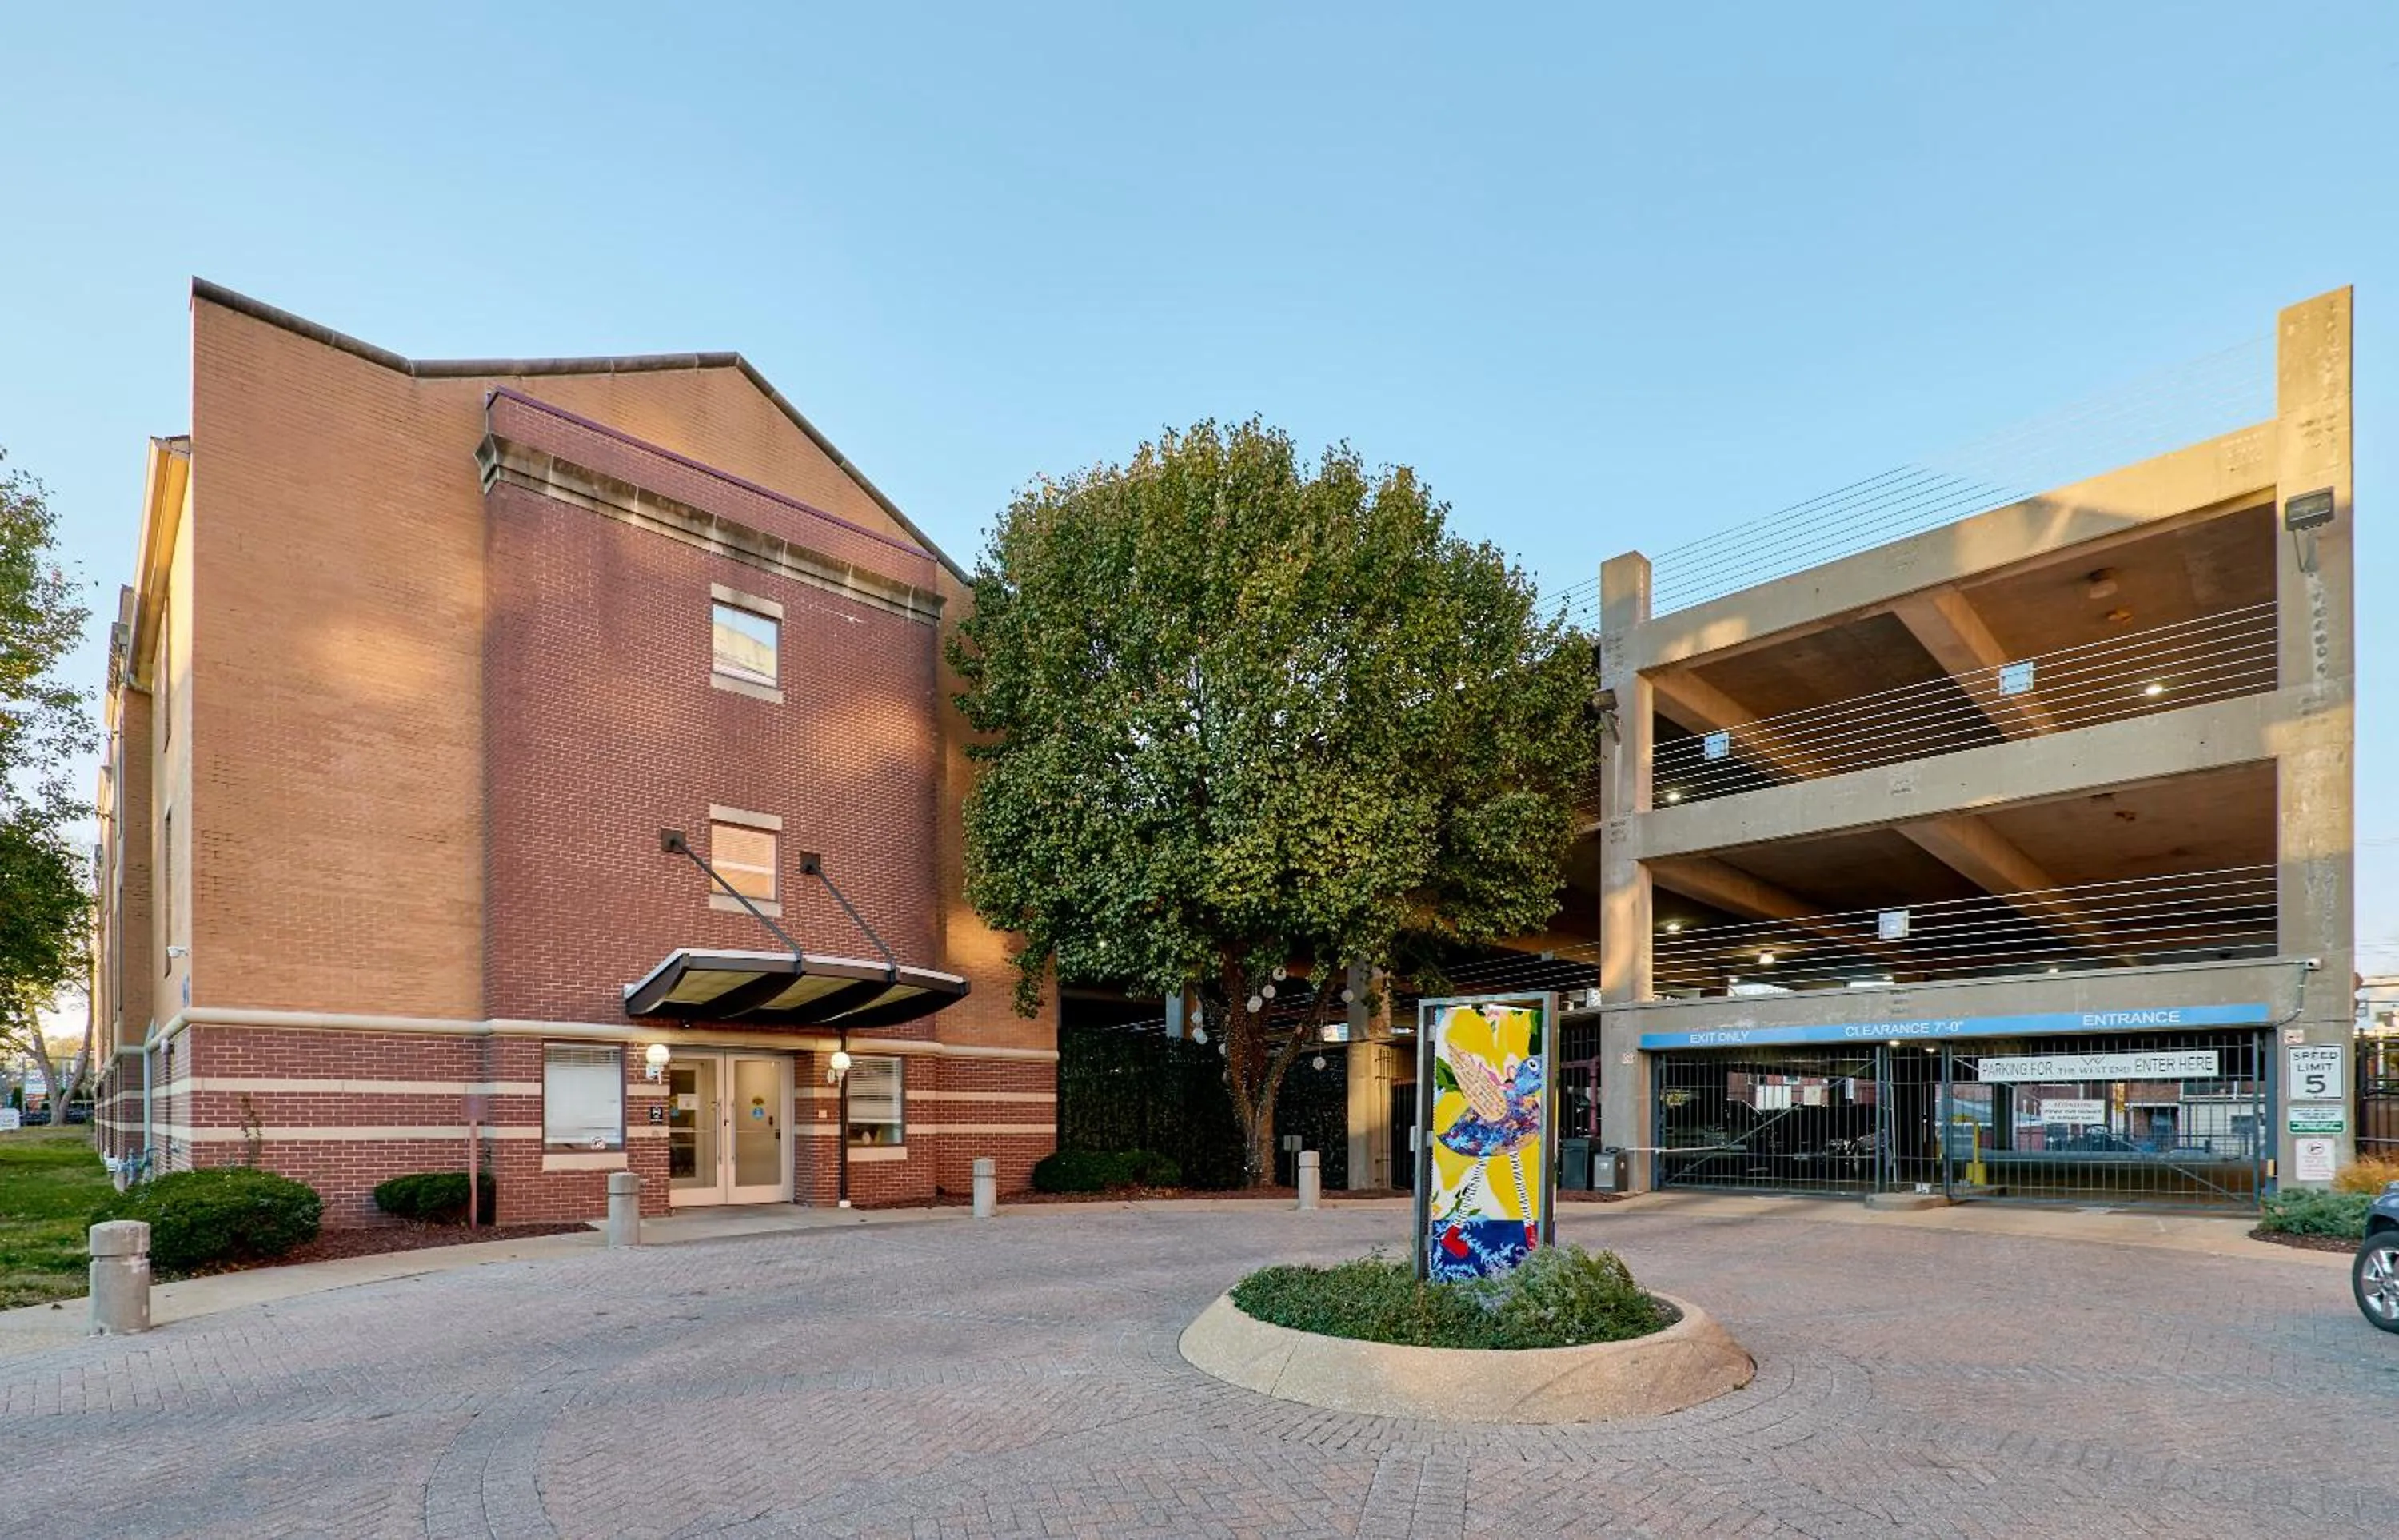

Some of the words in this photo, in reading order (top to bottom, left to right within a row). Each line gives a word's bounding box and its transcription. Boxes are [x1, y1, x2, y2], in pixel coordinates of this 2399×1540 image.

[2082, 1010, 2181, 1026] ENTRANCE
[1845, 1023, 1930, 1036] CLEARANCE
[1689, 1031, 1716, 1043] EXIT
[1717, 1030, 1750, 1043] ONLY
[2293, 1051, 2339, 1061] SPEED
[1982, 1062, 2027, 1076] PARKING
[2030, 1060, 2054, 1076] FOR
[2134, 1057, 2176, 1073] ENTER
[2179, 1055, 2213, 1072] HERE
[2297, 1063, 2333, 1072] LIMIT
[2305, 1074, 2326, 1094] 5
